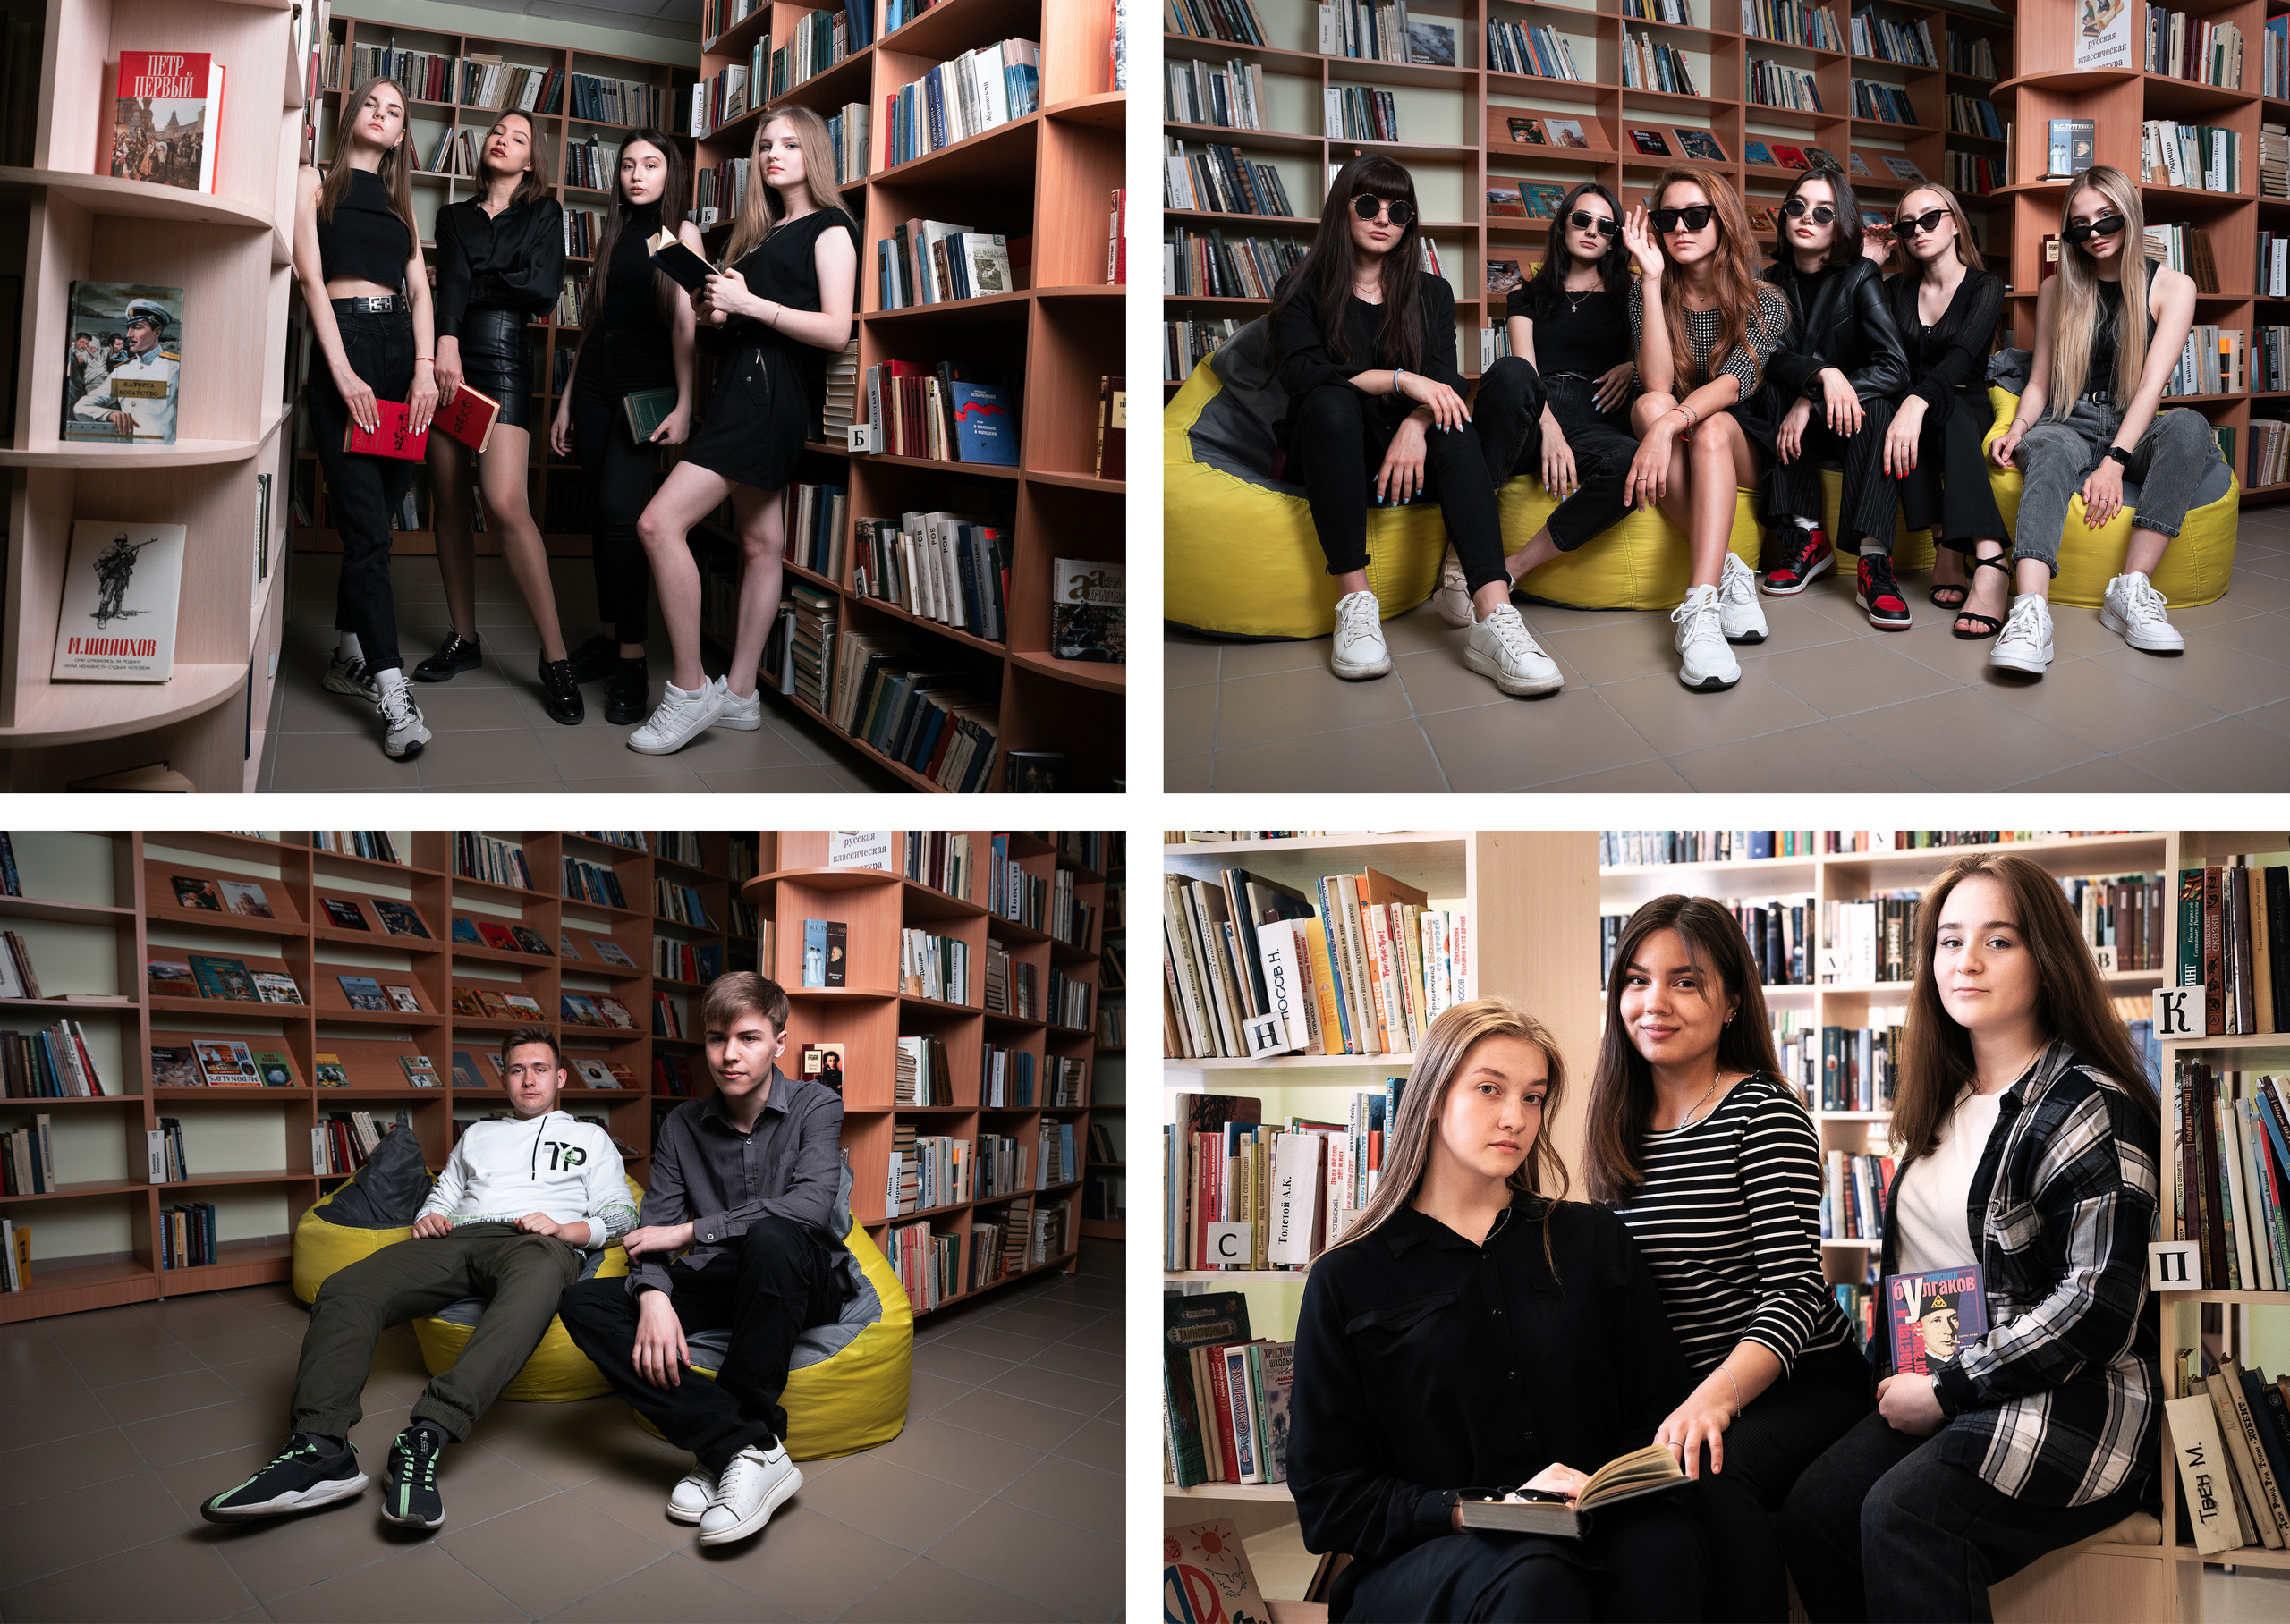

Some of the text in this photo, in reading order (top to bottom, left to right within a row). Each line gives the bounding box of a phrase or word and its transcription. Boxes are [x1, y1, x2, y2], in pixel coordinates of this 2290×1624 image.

[2078, 42, 2127, 64] классическая
[2088, 32, 2116, 49] русская
[148, 55, 184, 77] ПЕТР
[133, 72, 194, 97] ПЕРВЫЙ
[694, 101, 704, 130] Поэзия
[983, 81, 992, 123] Жуковский
[2166, 141, 2176, 174] РАДИЩЕВ
[704, 210, 711, 222] Б
[853, 430, 864, 446] Б
[972, 544, 982, 580] ВОЛОШИН
[856, 577, 862, 596] В
[68, 637, 157, 656] М.ШОЛОХОВ
[844, 832, 876, 849] русская
[833, 845, 887, 864] классическая
[1010, 866, 1019, 915] Повести
[1347, 903, 1356, 924] ГОРОДЕ
[1293, 930, 1302, 950] друзей
[1351, 926, 1362, 959] СОЛНЕЧНОМ
[1433, 918, 1442, 953] друзей
[2256, 921, 2264, 953] Итальянская
[1165, 957, 1173, 968] ВАС?
[1301, 937, 1311, 964] Незнайки
[1342, 946, 1351, 971] НЕЗНАЙКА
[1435, 956, 1443, 972] его
[1460, 950, 1468, 976] Незнайки
[1357, 966, 1367, 993] НЕЗНАЙКА
[1377, 930, 1395, 1026] Николай Носов Тук-Тук-Тук!
[1426, 919, 1438, 1018] Приключения Незнайки
[1187, 963, 1201, 1011] СЕРГЕЙ МИХАЛКОВ
[1348, 992, 1356, 1012] НИКОЛАЙ
[2159, 992, 2192, 1034] К
[1251, 1020, 1282, 1051] Н
[208, 1075, 259, 1083] McDONALD'S
[1058, 1095, 1065, 1104] Т
[2183, 1093, 2193, 1142] Шарль ПЕРРО
[1330, 1144, 1338, 1168] Фёдор,
[893, 1165, 903, 1205] Каренина
[1242, 1156, 1250, 1194] СКРЕБИЦКИЙ
[2261, 1170, 2275, 1223] Маленький Водяной
[1278, 1176, 1292, 1245] Толстой А.К.
[160, 1215, 168, 1256] СТРОИТЕЛЬСТВО
[1218, 1232, 1238, 1258] С
[2156, 1251, 2190, 1282] П
[1230, 1366, 1248, 1434] С.МАРШАК
[1260, 1418, 1268, 1446] ШКОЛЬНИКА
[2237, 1401, 2258, 1441] ХОББИТ
[1264, 1447, 1272, 1477] ХРЕСТОМАТИЯ
[2254, 1446, 2267, 1469] Толкин
[2184, 1442, 2218, 1527] ТВЕН М.
[2276, 1511, 2290, 1530] Джон
